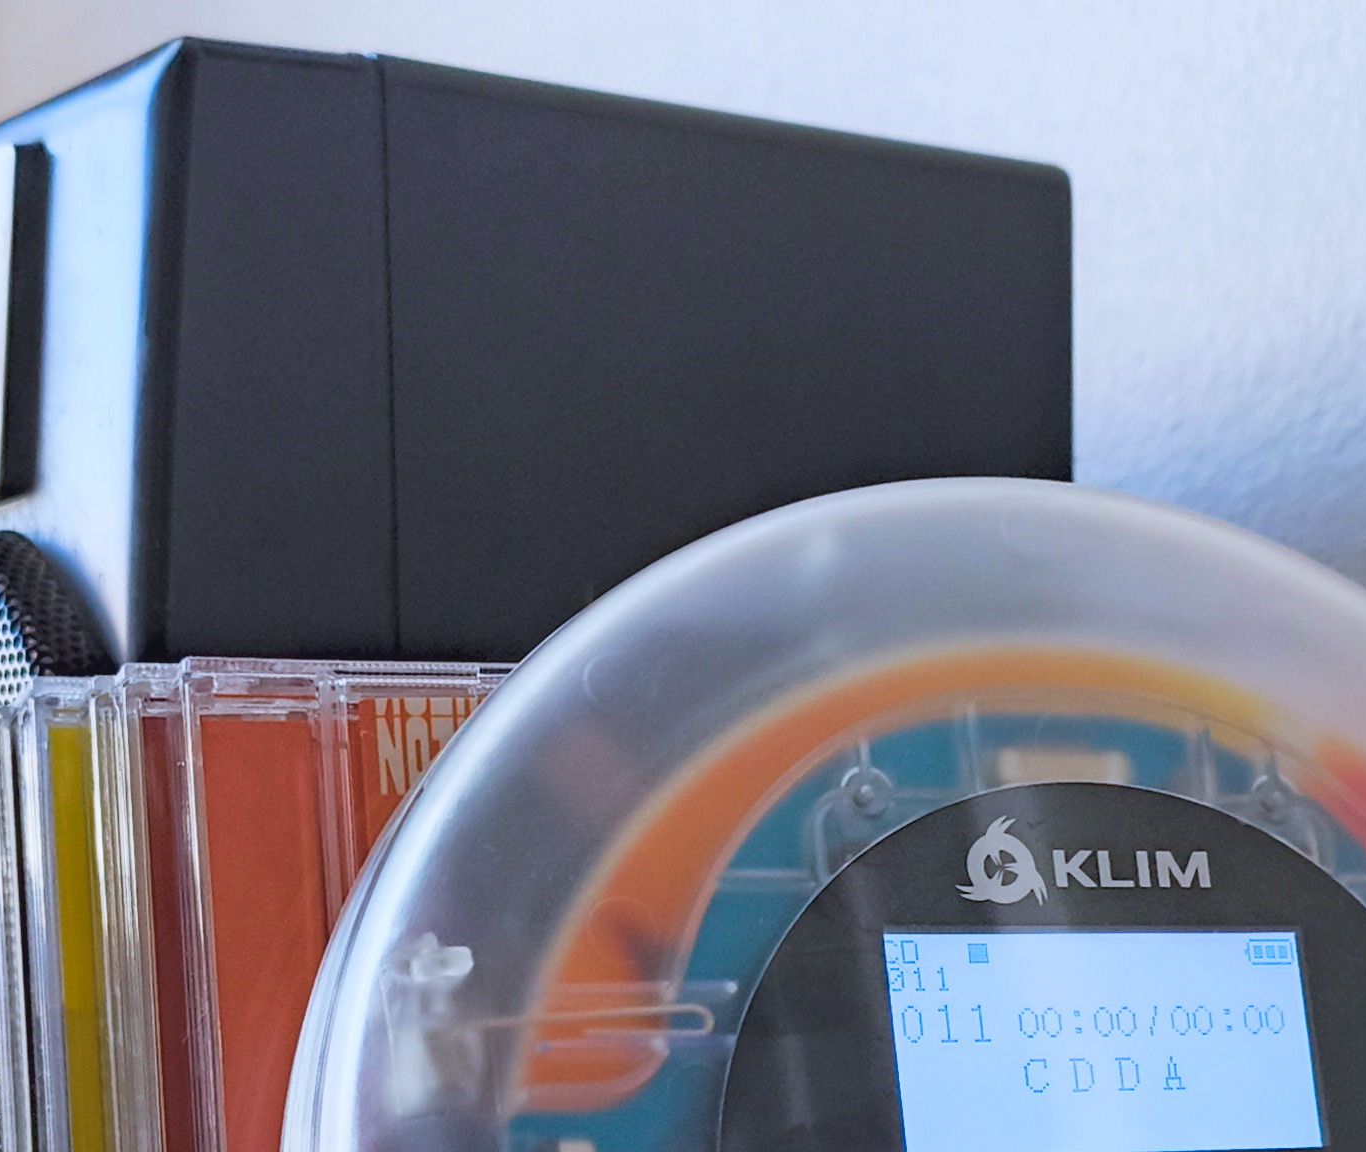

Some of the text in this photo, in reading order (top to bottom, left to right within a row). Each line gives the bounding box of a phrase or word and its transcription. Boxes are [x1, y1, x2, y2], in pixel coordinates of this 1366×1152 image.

[1052, 849, 1212, 888] KLIM
[885, 939, 919, 964] CD
[890, 967, 949, 992] 011
[901, 1004, 1286, 1043] 011 00:00/00:00
